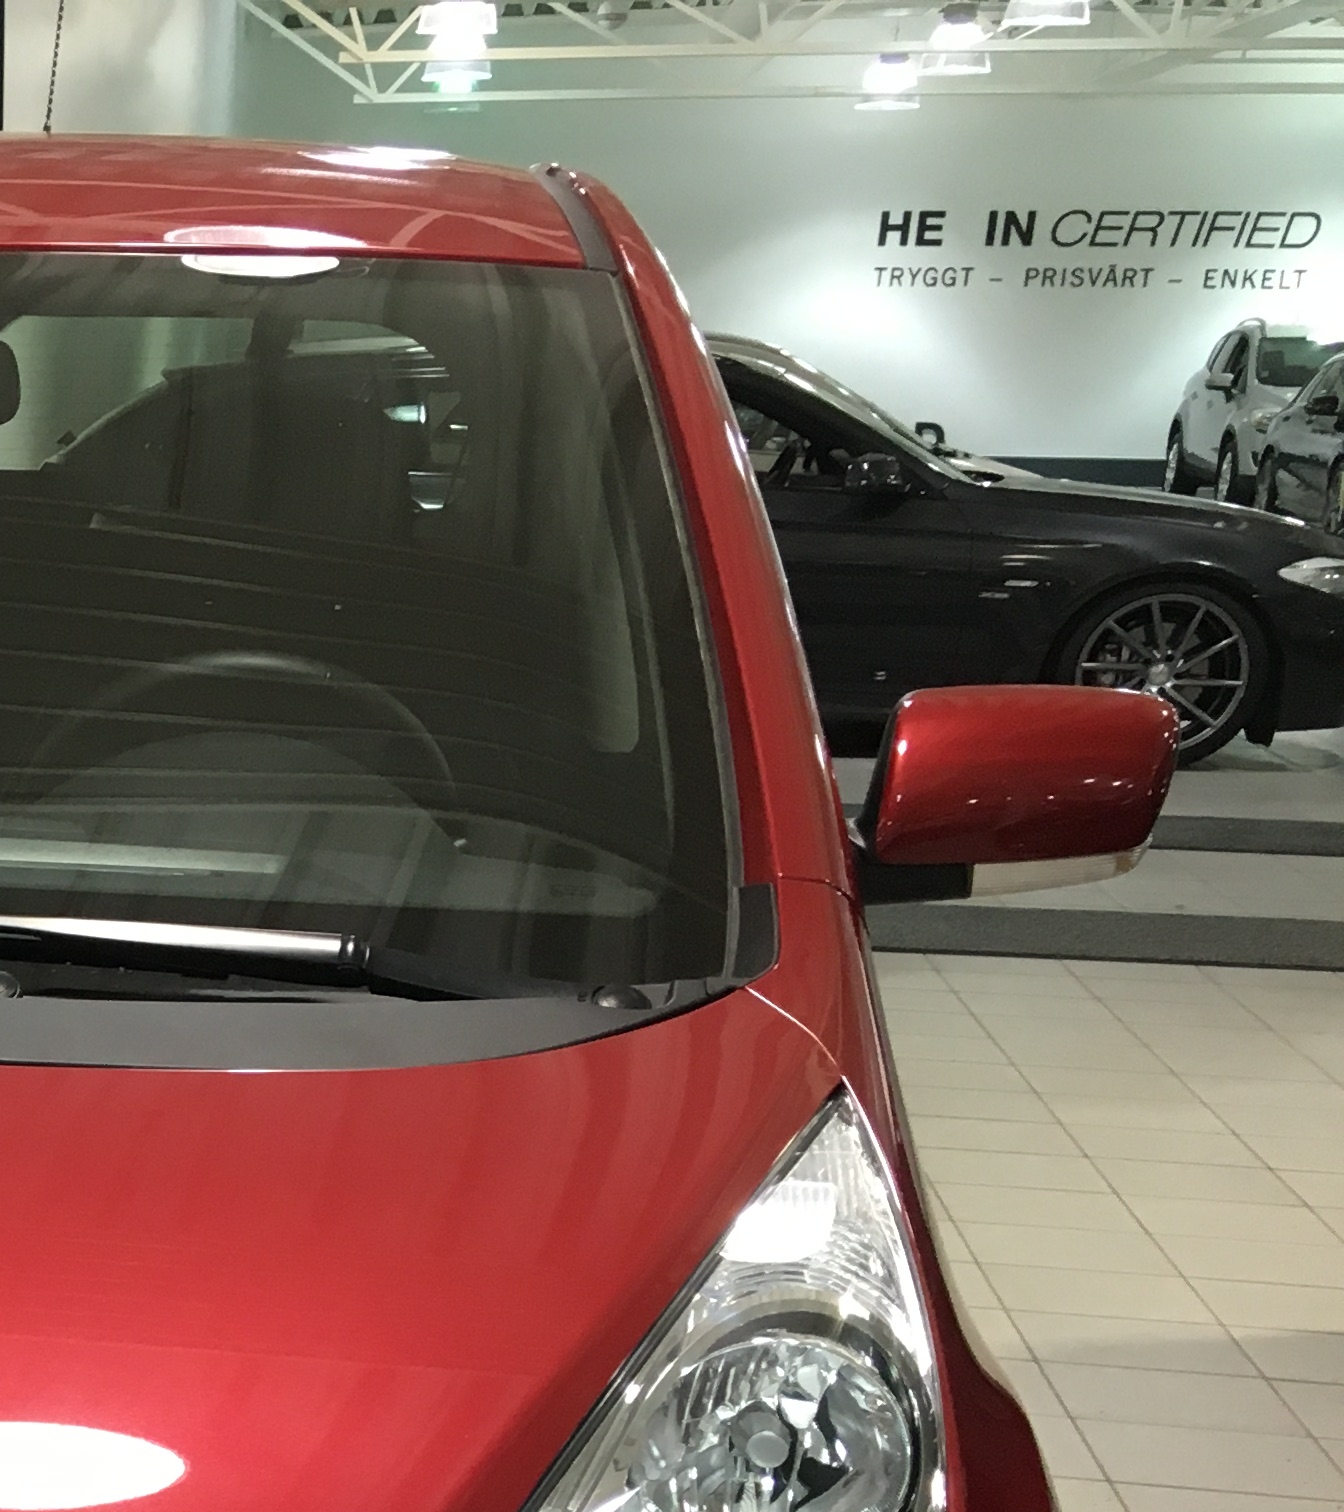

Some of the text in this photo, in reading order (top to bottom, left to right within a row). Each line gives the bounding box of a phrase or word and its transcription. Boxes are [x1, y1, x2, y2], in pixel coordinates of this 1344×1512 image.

[1050, 209, 1322, 249] CERTIFIED
[873, 266, 975, 287] TRYGGT
[1202, 268, 1308, 290] ENKELT
